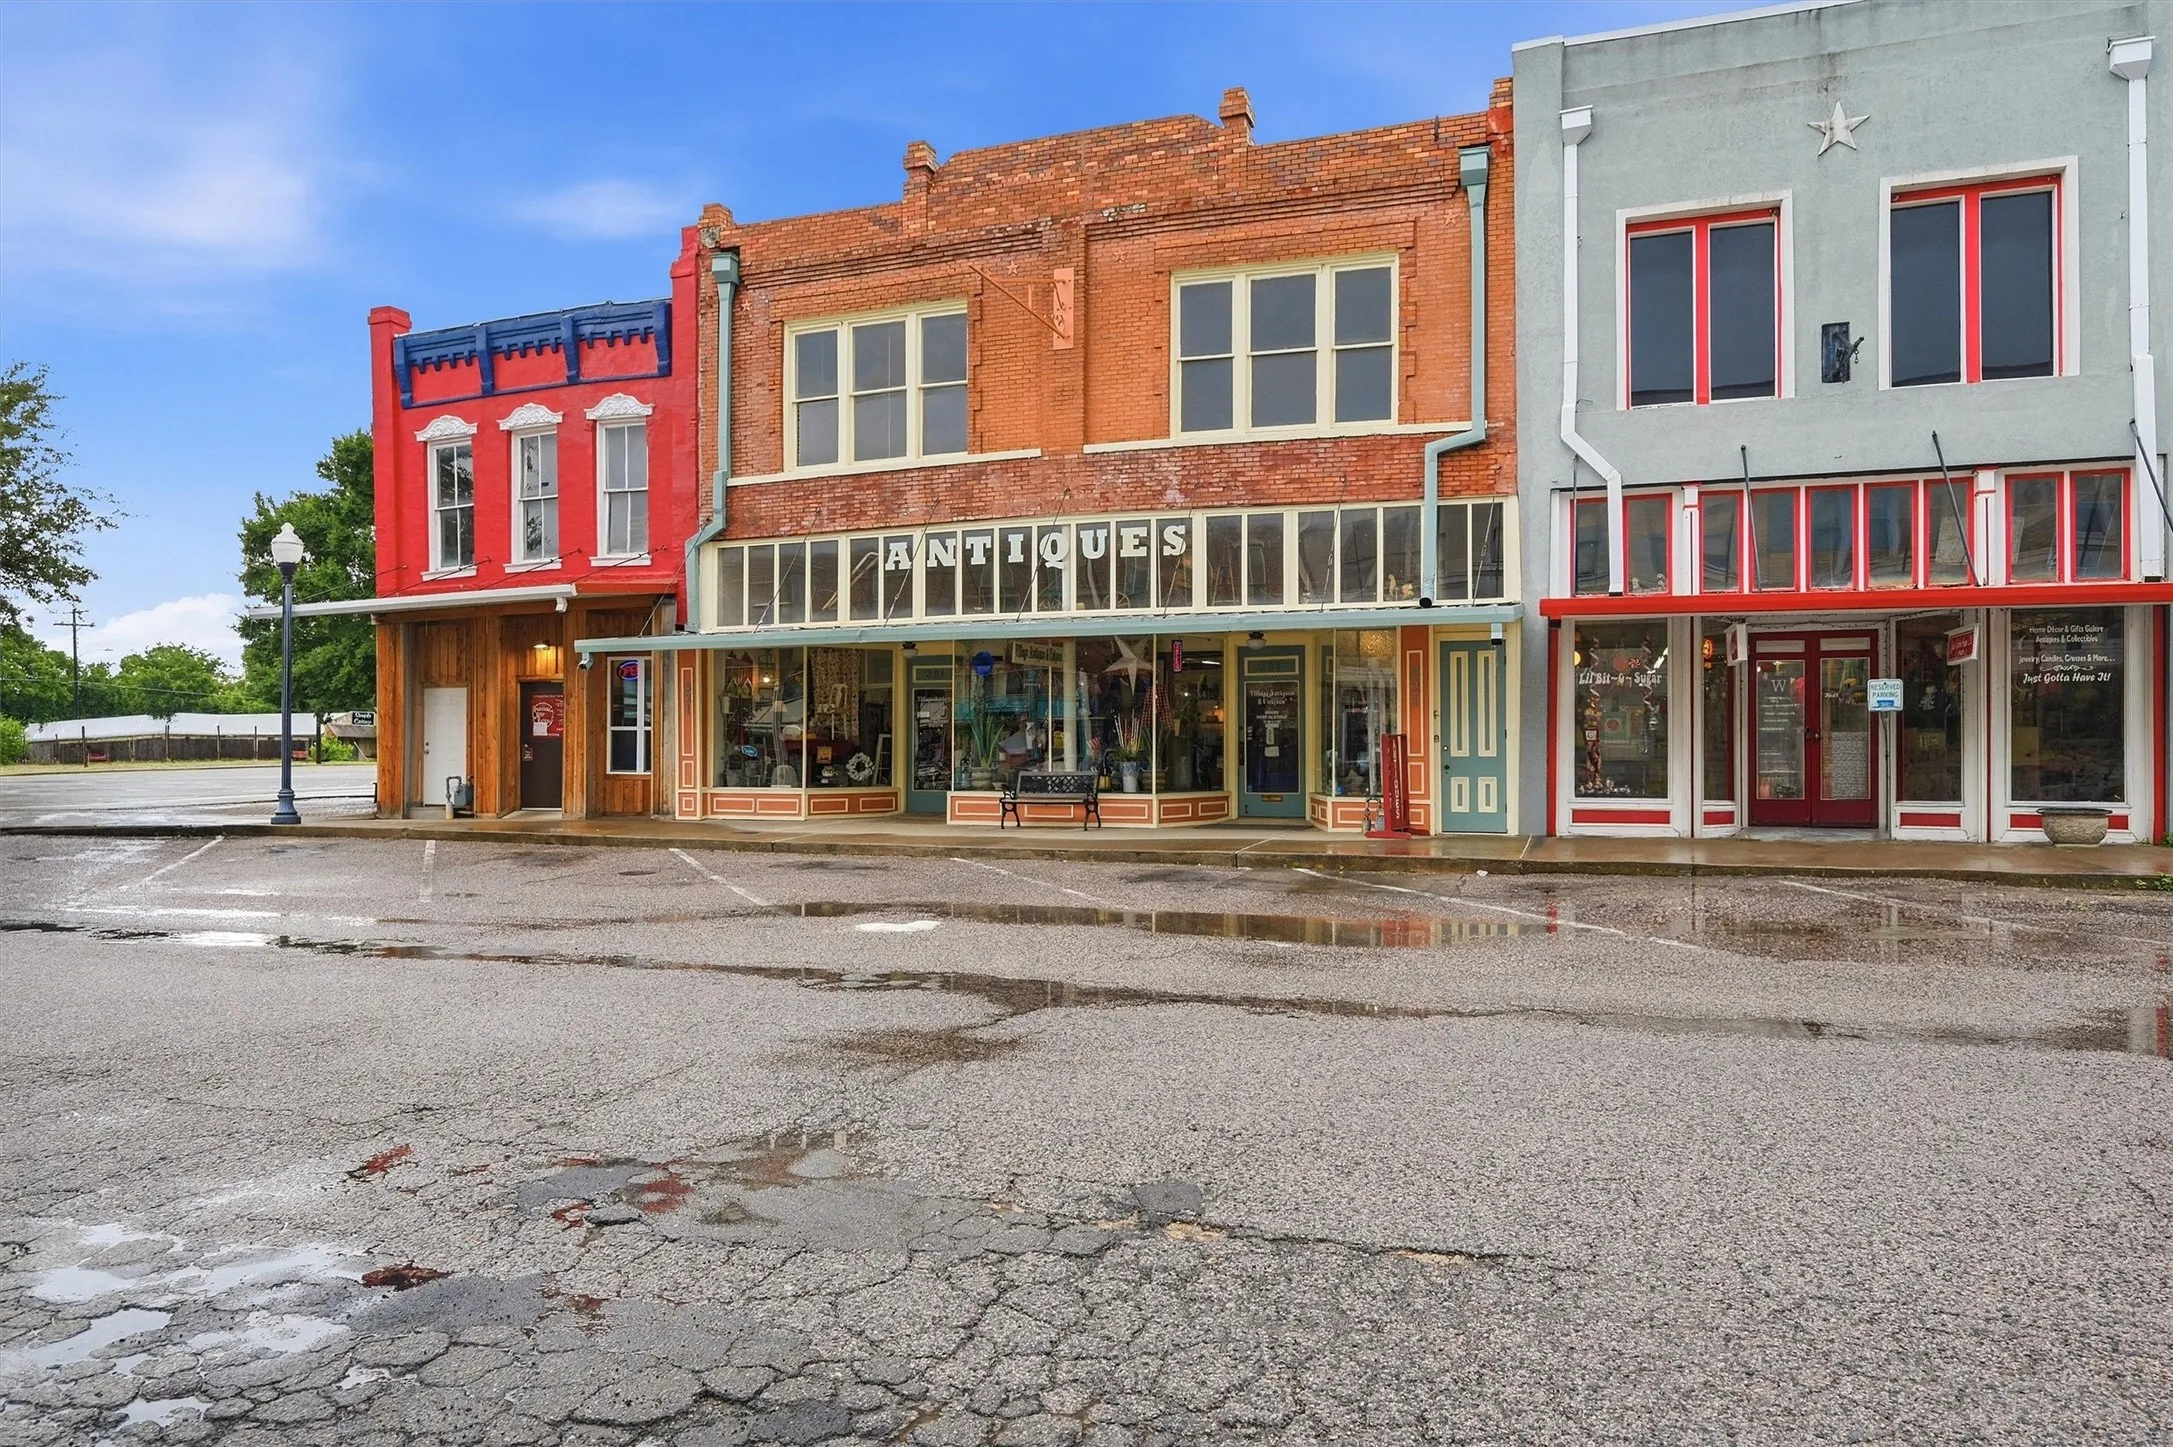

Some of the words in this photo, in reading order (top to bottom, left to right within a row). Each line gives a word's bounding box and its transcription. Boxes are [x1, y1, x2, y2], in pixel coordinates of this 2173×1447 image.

[885, 524, 1187, 571] ANTIQUES
[2066, 634, 2098, 643] Collectibles
[1634, 671, 1662, 686] Sugar
[2023, 674, 2041, 684] Just
[2044, 673, 2070, 684] Gotta
[2072, 672, 2096, 682] Have
[1771, 679, 1787, 692] W
